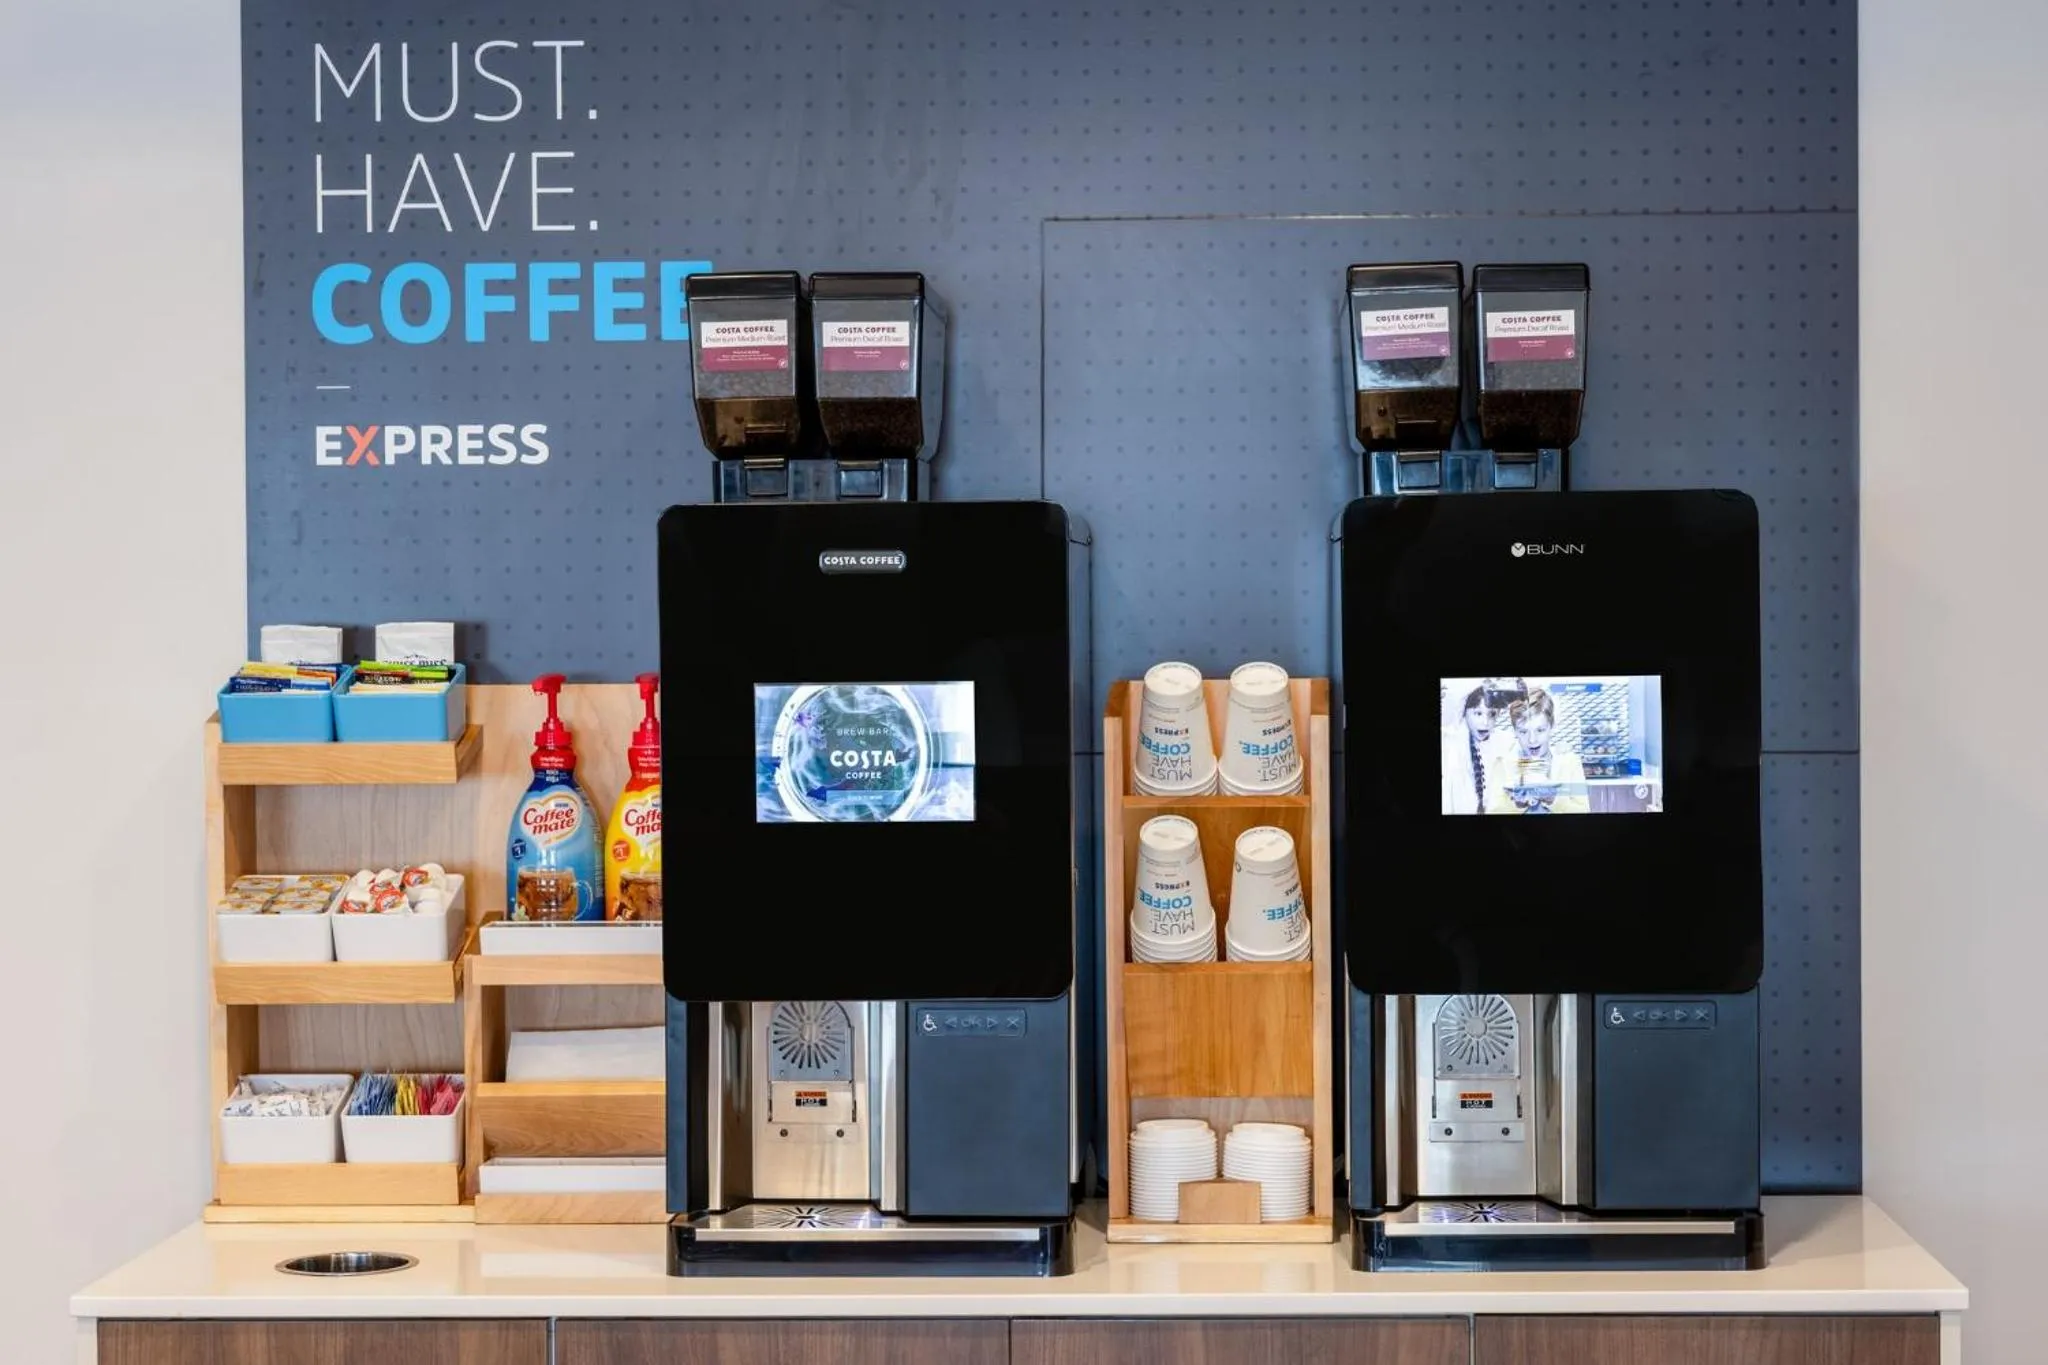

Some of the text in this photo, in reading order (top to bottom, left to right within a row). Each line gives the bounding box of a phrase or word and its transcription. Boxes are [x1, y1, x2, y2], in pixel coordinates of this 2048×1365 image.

[315, 40, 598, 122] MUST.
[316, 152, 598, 233] HAVE.
[1529, 315, 1562, 323] COFFEE
[743, 325, 775, 333] COFFEE
[838, 326, 897, 334] COSTA COFFEE
[316, 424, 549, 466] EXPRESS
[1527, 544, 1584, 555] BUNN
[824, 556, 900, 565] COSTA COFFEE
[836, 727, 889, 736] BREW BAR
[830, 750, 896, 769] COSTA
[523, 808, 574, 826] Coffee
[532, 818, 575, 836] mate
